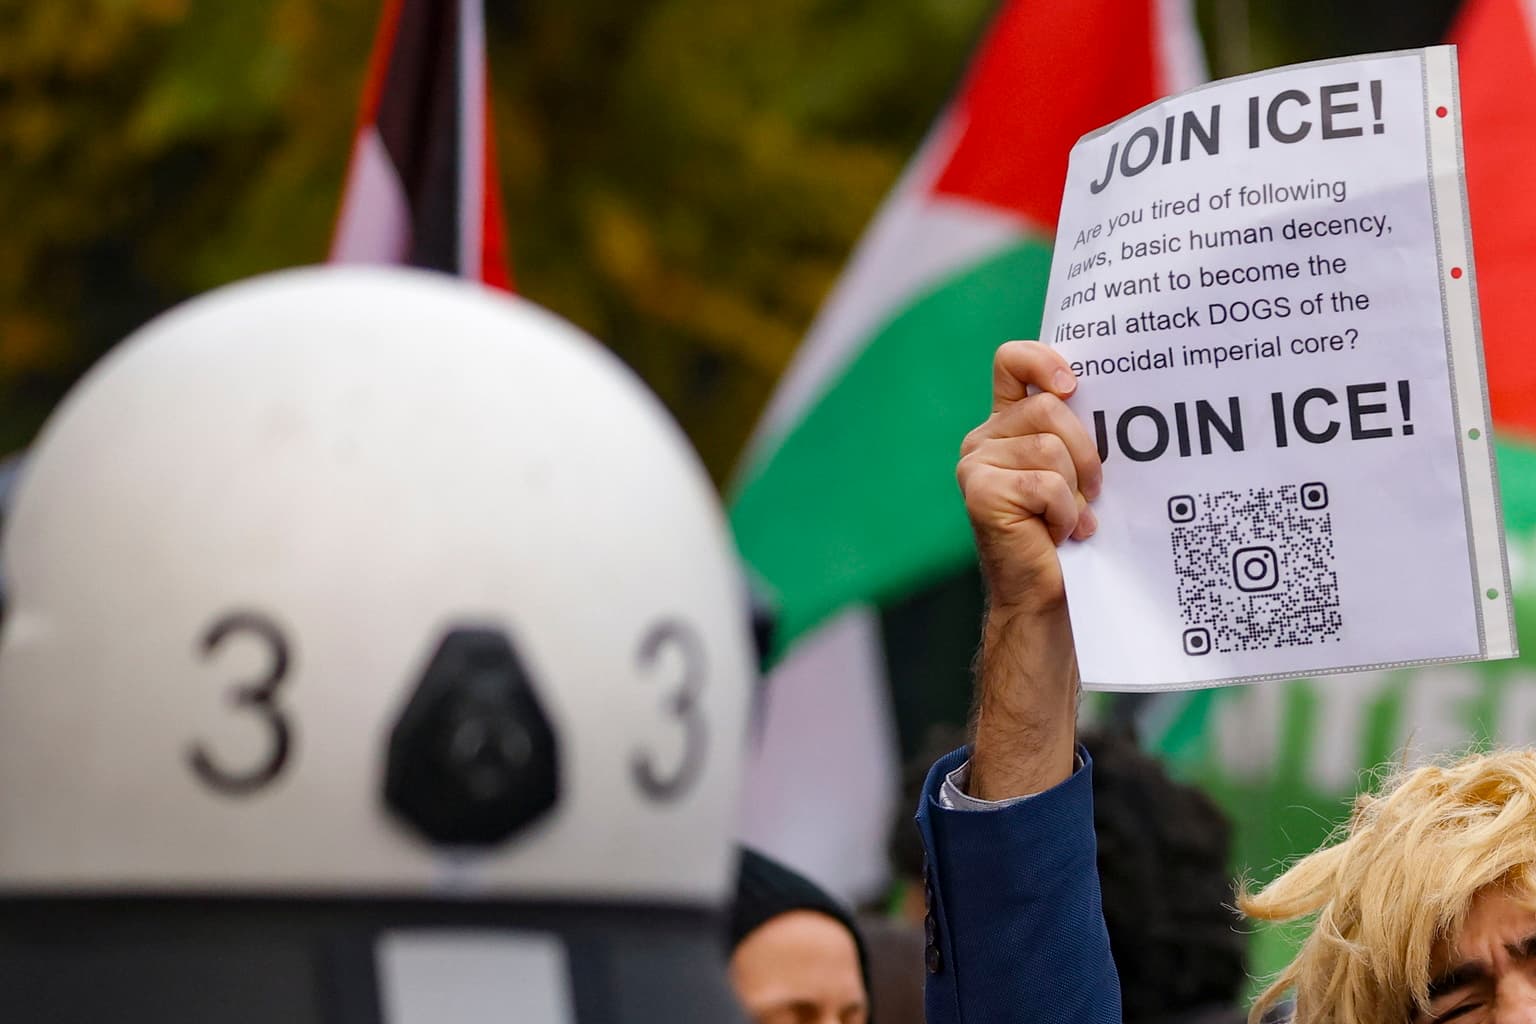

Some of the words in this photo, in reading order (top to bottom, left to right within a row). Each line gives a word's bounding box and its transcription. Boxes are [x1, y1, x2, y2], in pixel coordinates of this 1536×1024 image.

[1089, 104, 1221, 195] JOIN
[1248, 79, 1385, 150] ICE!
[1067, 250, 1112, 281] laws,
[1120, 232, 1181, 261] basic
[1188, 224, 1273, 251] human
[1281, 213, 1393, 242] decency,
[1073, 223, 1102, 250] Are
[1107, 207, 1144, 236] you
[1151, 193, 1200, 221] tired
[1208, 187, 1231, 211] of
[1238, 178, 1347, 208] following
[1054, 315, 1117, 344] literal
[1125, 307, 1201, 334] attack
[1208, 297, 1292, 326] DOGS
[1299, 293, 1325, 315] of
[1330, 290, 1370, 312] the
[1060, 283, 1096, 311] and
[1103, 273, 1161, 299] want
[1168, 270, 1191, 290] to
[1199, 260, 1301, 288] become
[1307, 255, 1347, 277] the
[1069, 347, 1174, 379] enocidal
[1182, 335, 1282, 369] imperial
[1289, 327, 1360, 356] core?
[1270, 379, 1415, 448] ICE!
[184, 608, 294, 800] 3
[628, 613, 711, 808] 3
